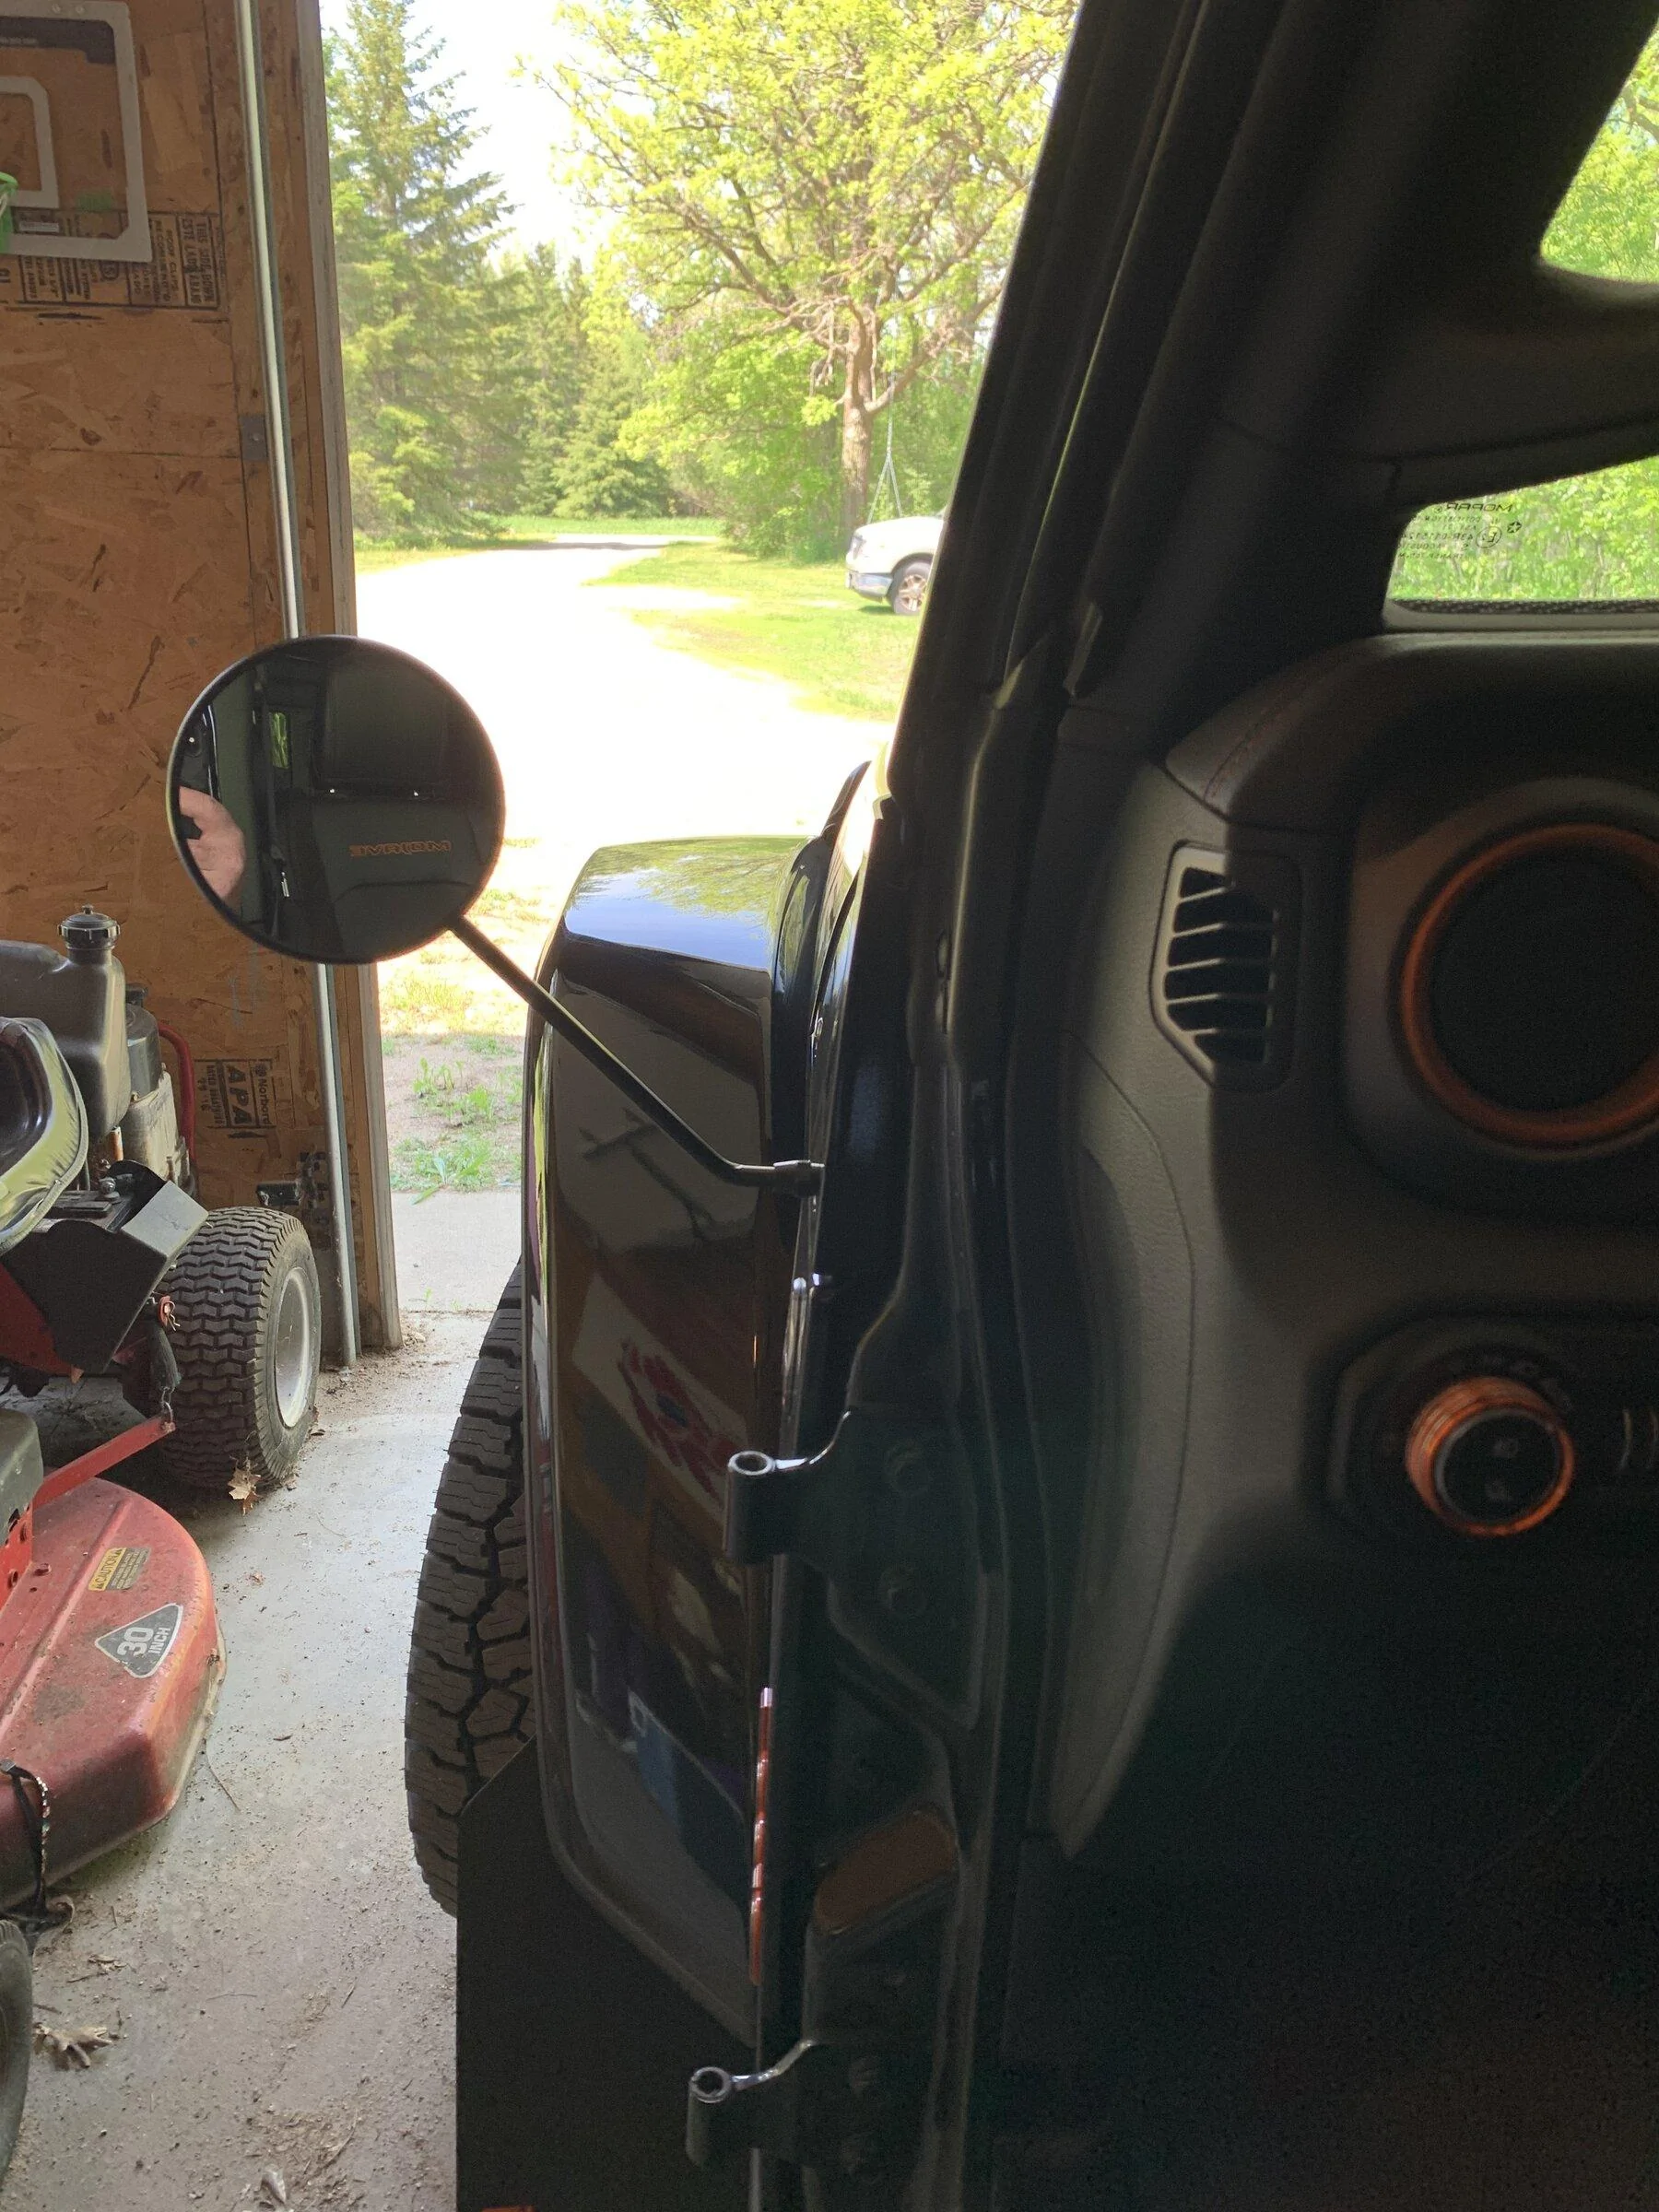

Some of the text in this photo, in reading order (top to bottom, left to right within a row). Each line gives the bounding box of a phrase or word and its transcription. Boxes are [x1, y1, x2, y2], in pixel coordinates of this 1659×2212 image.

[227, 1065, 253, 1124] APA
[258, 1078, 273, 1124] Norbord
[94, 1552, 119, 1583] CAUTION
[116, 1627, 154, 1656] 30
[147, 1627, 171, 1654] INCH
